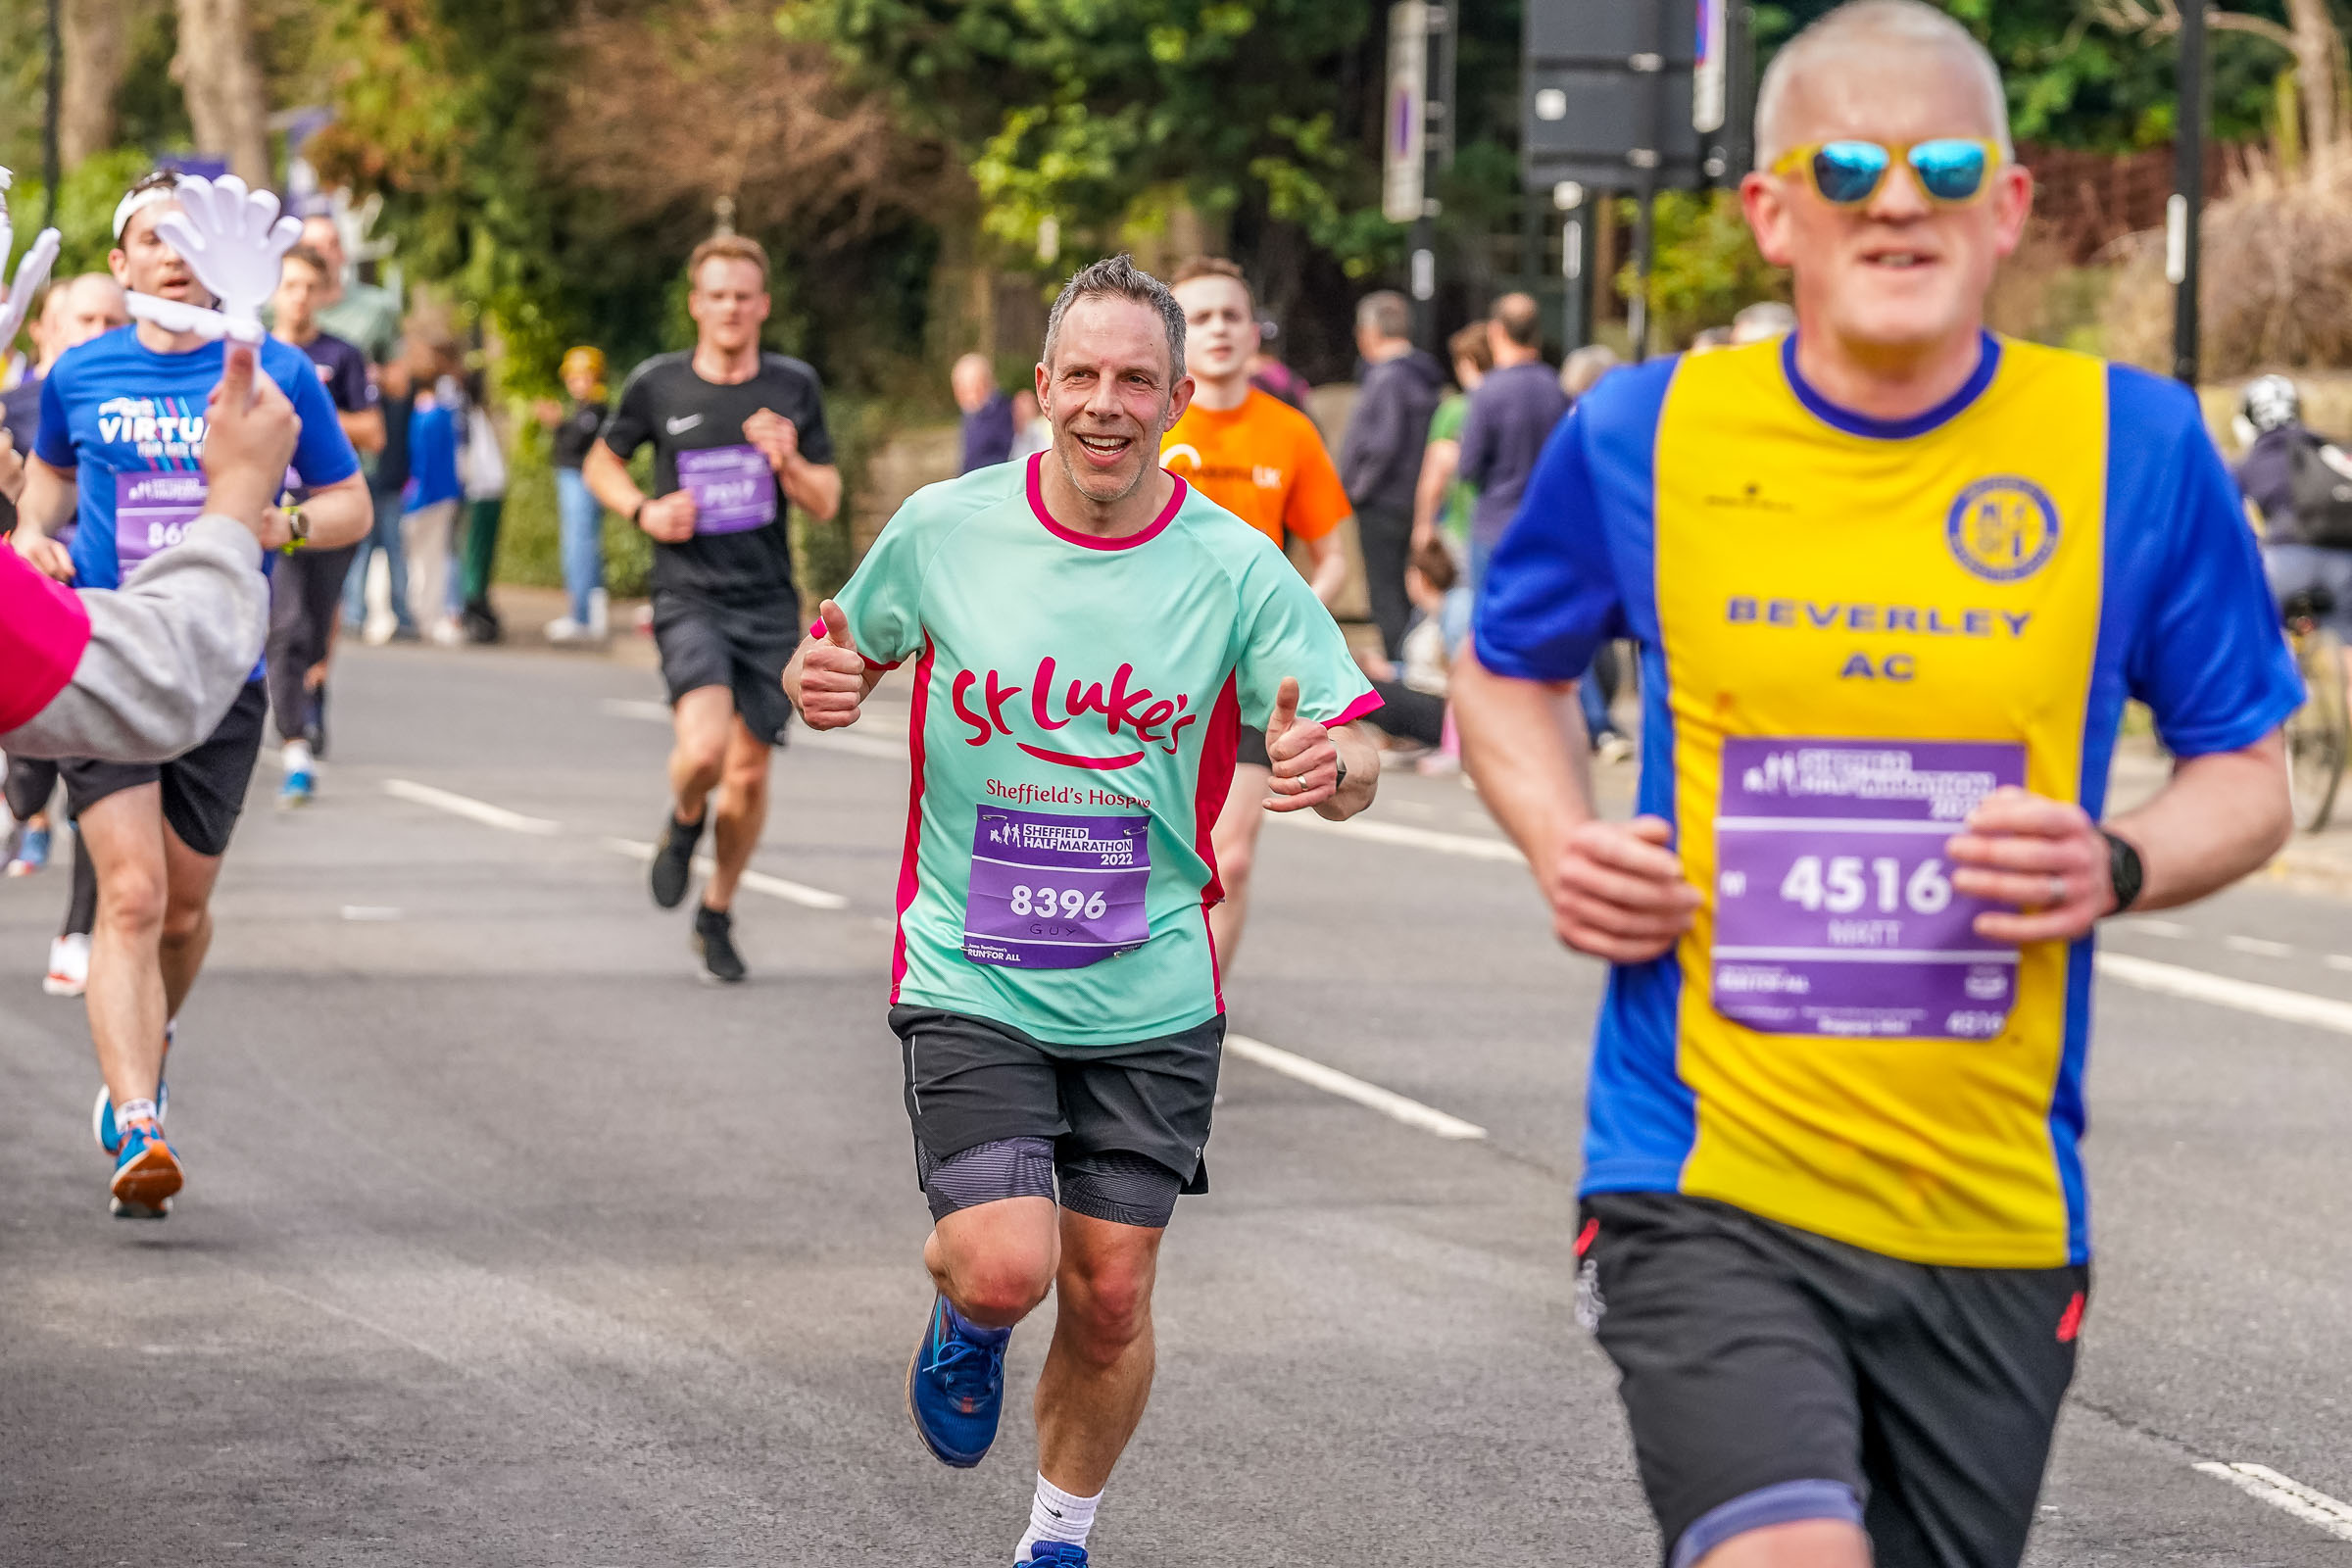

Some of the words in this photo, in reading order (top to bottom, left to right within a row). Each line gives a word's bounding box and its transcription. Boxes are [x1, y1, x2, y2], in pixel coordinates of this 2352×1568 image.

[99, 416, 210, 443] VIRTU
[1727, 597, 2033, 638] BEVERLEY
[1839, 652, 1917, 682] AC
[952, 668, 1023, 747] St
[1031, 656, 1198, 755] Luke's
[986, 778, 1083, 806] Sheffield's
[1024, 825, 1087, 839] SHEFFIELD
[1024, 837, 1057, 850] HALF
[1058, 839, 1132, 853] MARATHON
[1100, 853, 1133, 865] 2022
[1780, 855, 1952, 915] 4516
[1009, 884, 1107, 919] 8396
[1030, 923, 1076, 937] GUY
[967, 949, 986, 958] RUN
[1005, 953, 1021, 962] ALL
